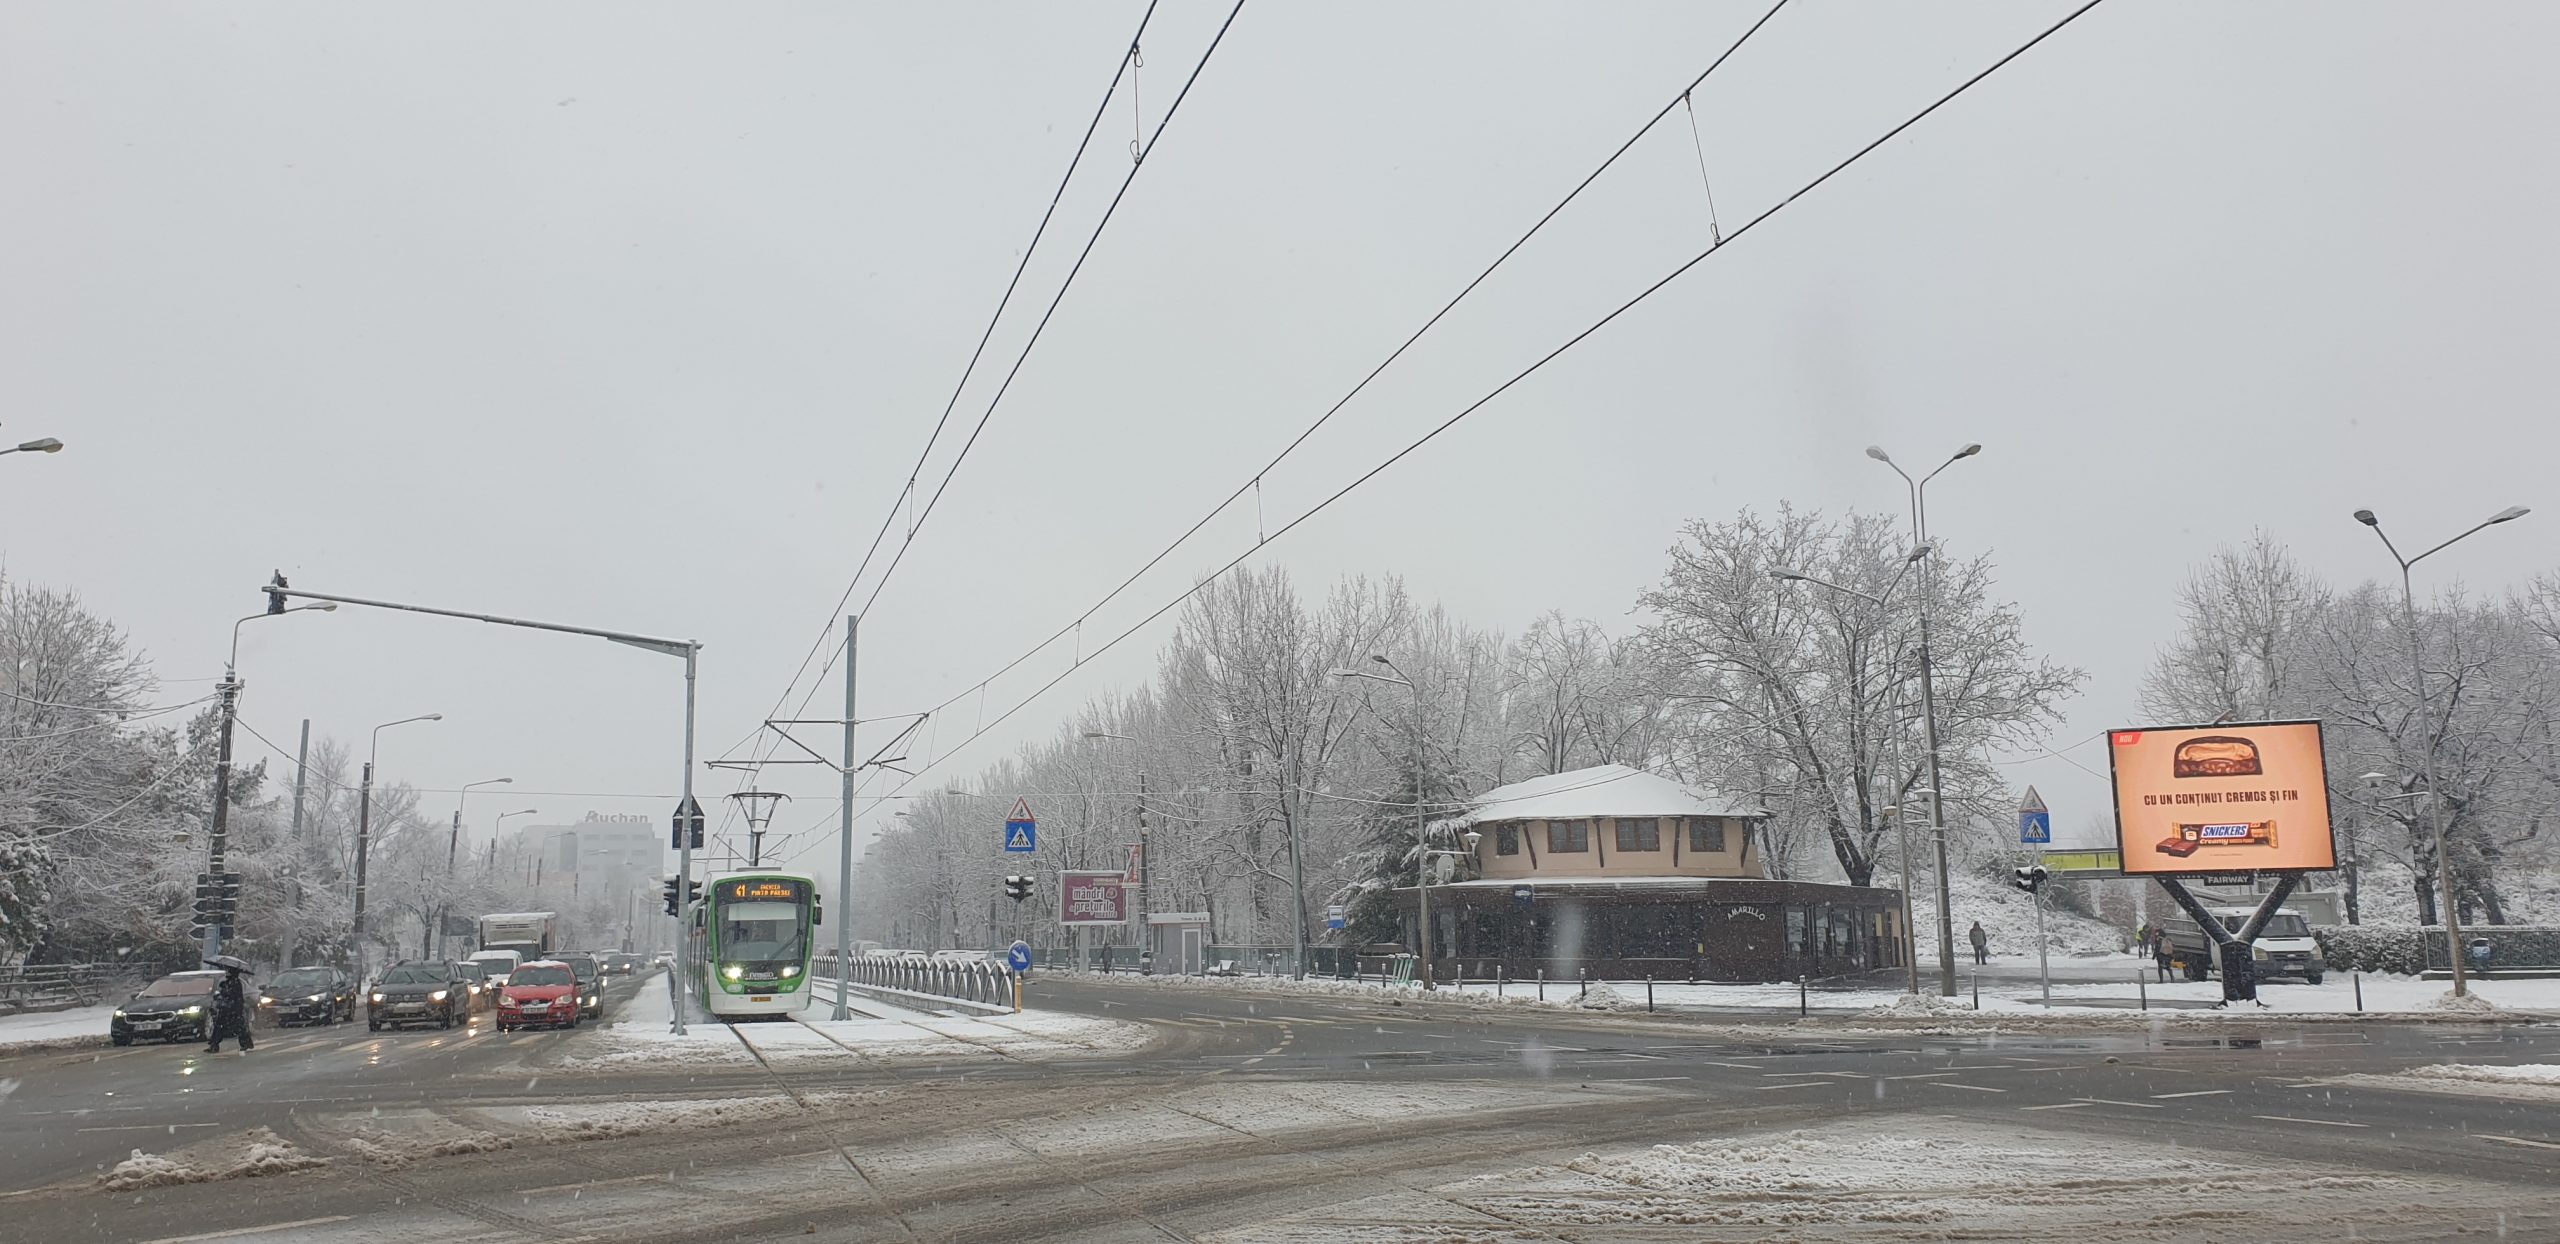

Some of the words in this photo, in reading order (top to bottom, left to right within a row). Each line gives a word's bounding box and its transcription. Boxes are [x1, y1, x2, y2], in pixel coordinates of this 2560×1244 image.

[2144, 795, 2157, 806] CU
[2160, 794, 2173, 805] UN
[2175, 793, 2223, 807] CONȚINUT
[2226, 791, 2267, 803] CREMOS
[2270, 790, 2280, 804] ȘI
[2282, 790, 2298, 801] FIN
[585, 810, 649, 823] Auchan
[2203, 826, 2247, 836] SNICKERS
[2208, 876, 2249, 884] FAIRWAY
[736, 884, 746, 897] 41
[1073, 887, 1104, 899] mândri
[1075, 901, 1114, 914] prețurile
[1727, 906, 1766, 921] AMARILLO
